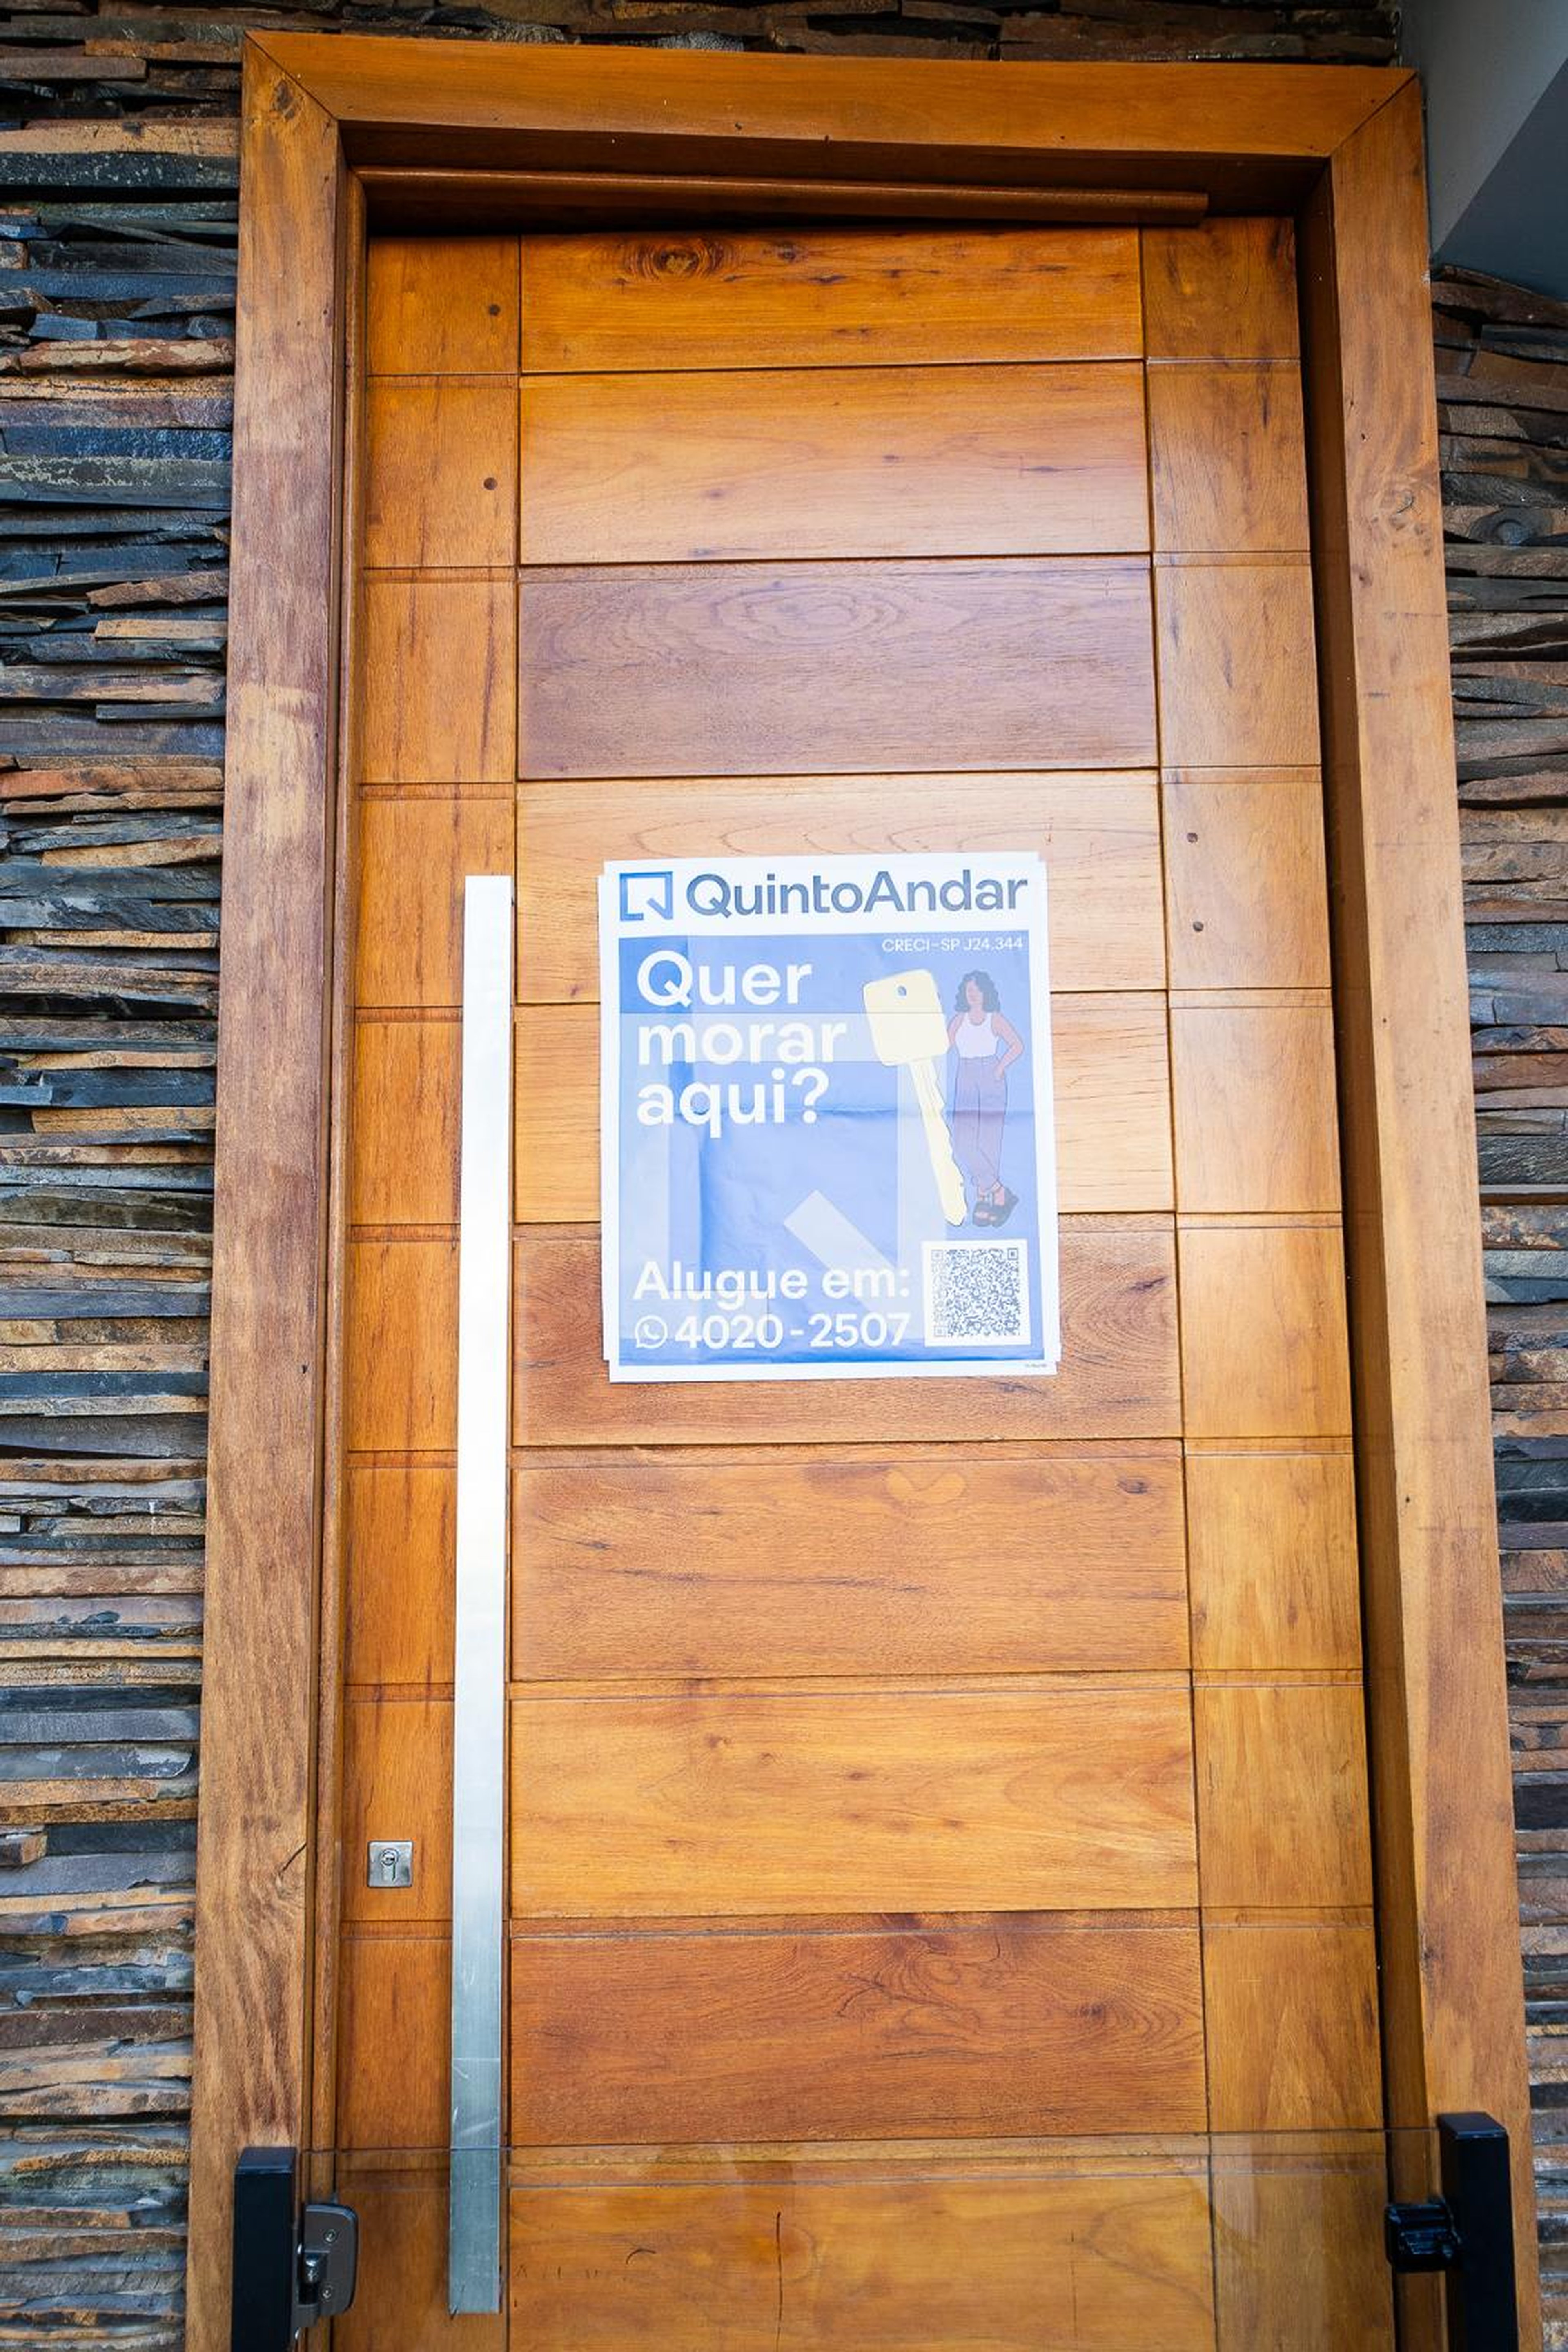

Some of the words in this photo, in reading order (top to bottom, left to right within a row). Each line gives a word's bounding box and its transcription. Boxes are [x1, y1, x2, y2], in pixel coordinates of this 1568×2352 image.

[686, 869, 1028, 918] QuintoAndar
[882, 939, 960, 953] CRECI-SP
[964, 937, 1024, 951] J24.344
[637, 950, 813, 1008] Quer
[638, 1022, 848, 1065] morar
[637, 1068, 830, 1138] aqui?
[633, 1261, 808, 1310] Alugue
[821, 1264, 910, 1300] em:
